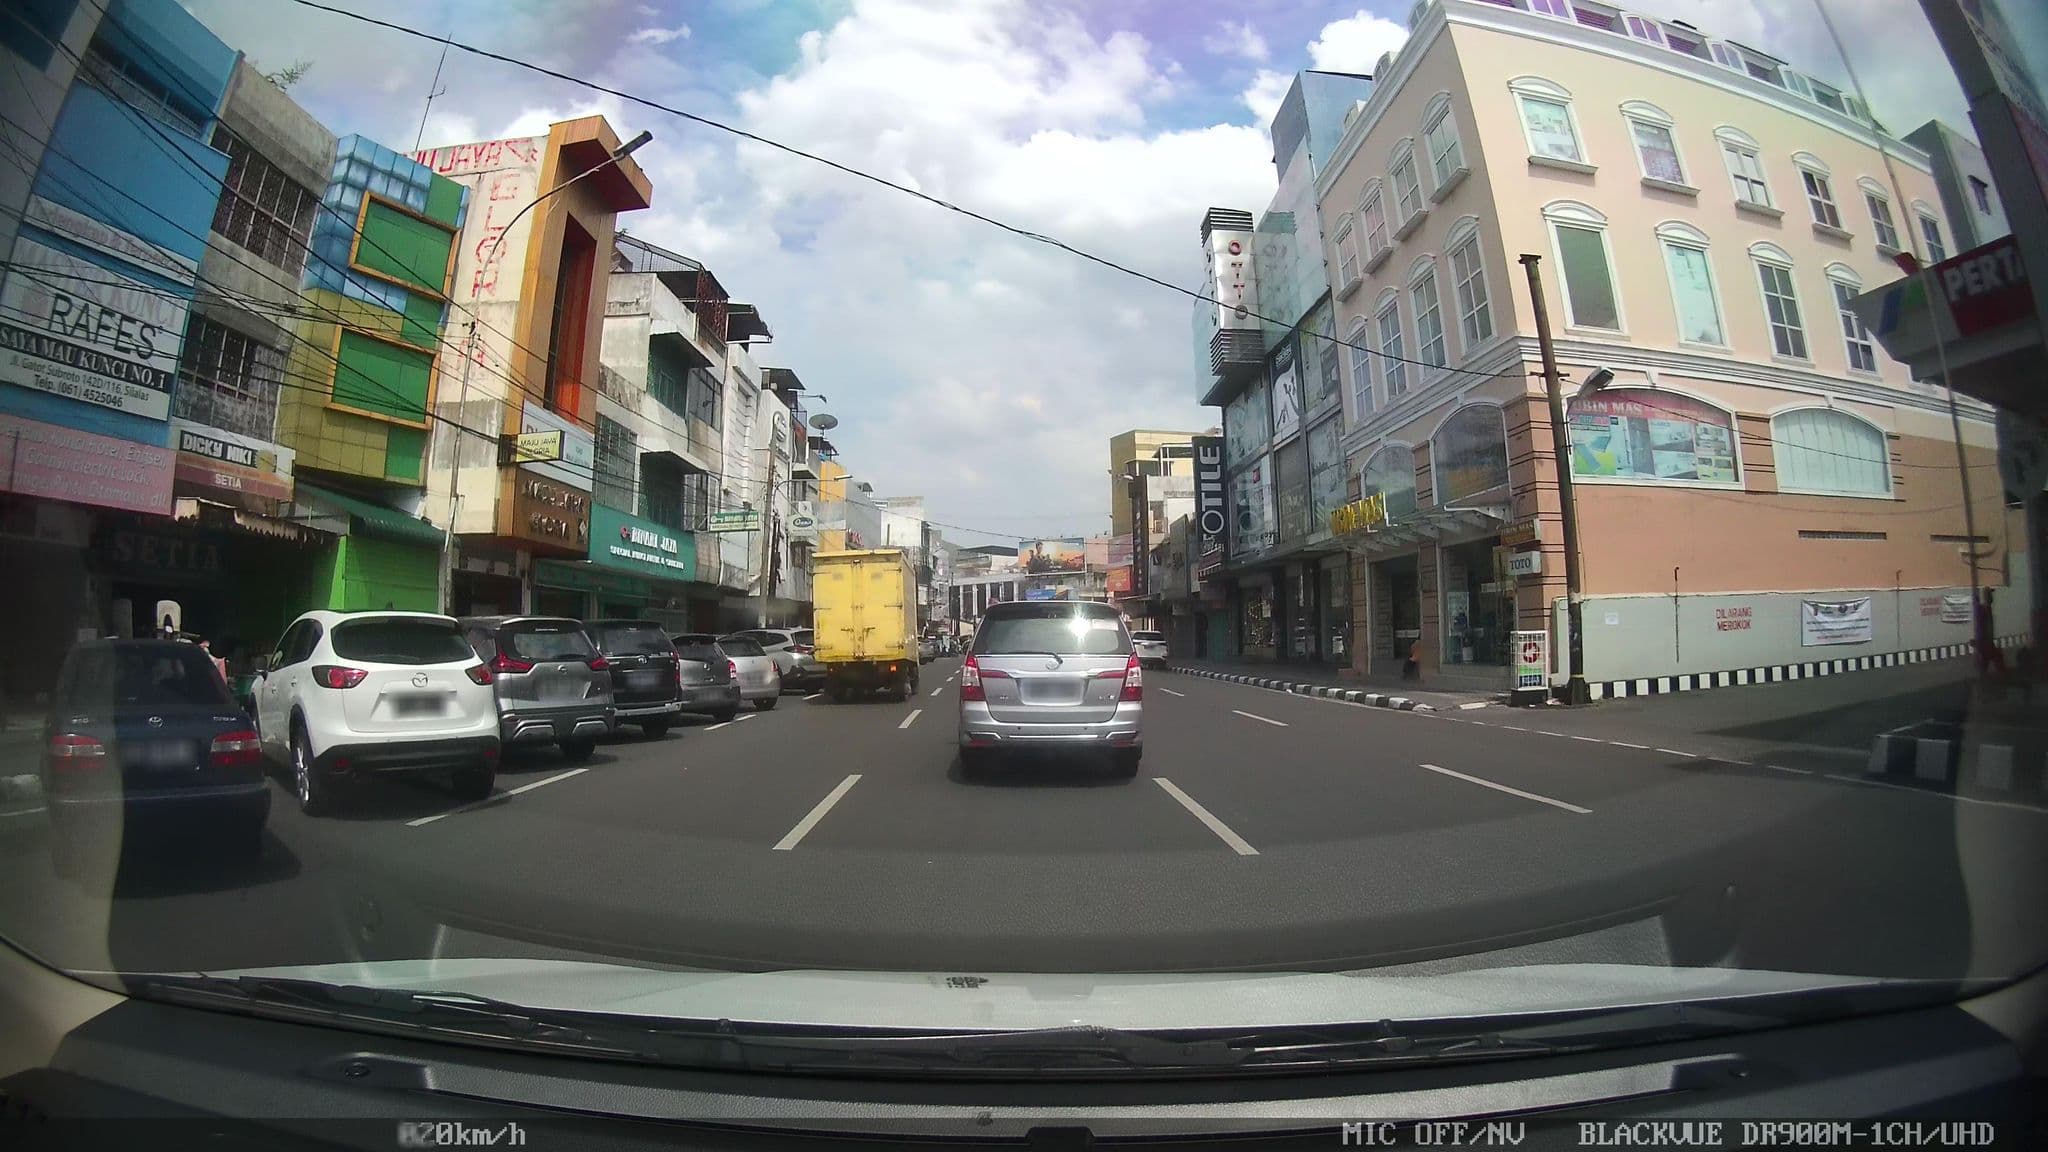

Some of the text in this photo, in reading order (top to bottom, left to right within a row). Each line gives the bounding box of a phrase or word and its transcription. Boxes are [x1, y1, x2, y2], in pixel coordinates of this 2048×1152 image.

[50, 293, 157, 361] RAFES
[41, 337, 77, 364] MAU
[80, 350, 128, 381] KUNCI
[130, 365, 155, 385] NO.
[159, 373, 166, 389] 1
[47, 364, 81, 383] Subroto
[34, 374, 124, 408] Telp. (061) 4525046
[183, 433, 253, 465] DICKY NIKI
[215, 473, 242, 489] SETIA
[1510, 557, 1531, 570] TOTO
[1716, 607, 1752, 619] DILARANG
[1717, 619, 1751, 631] MEROKOK
